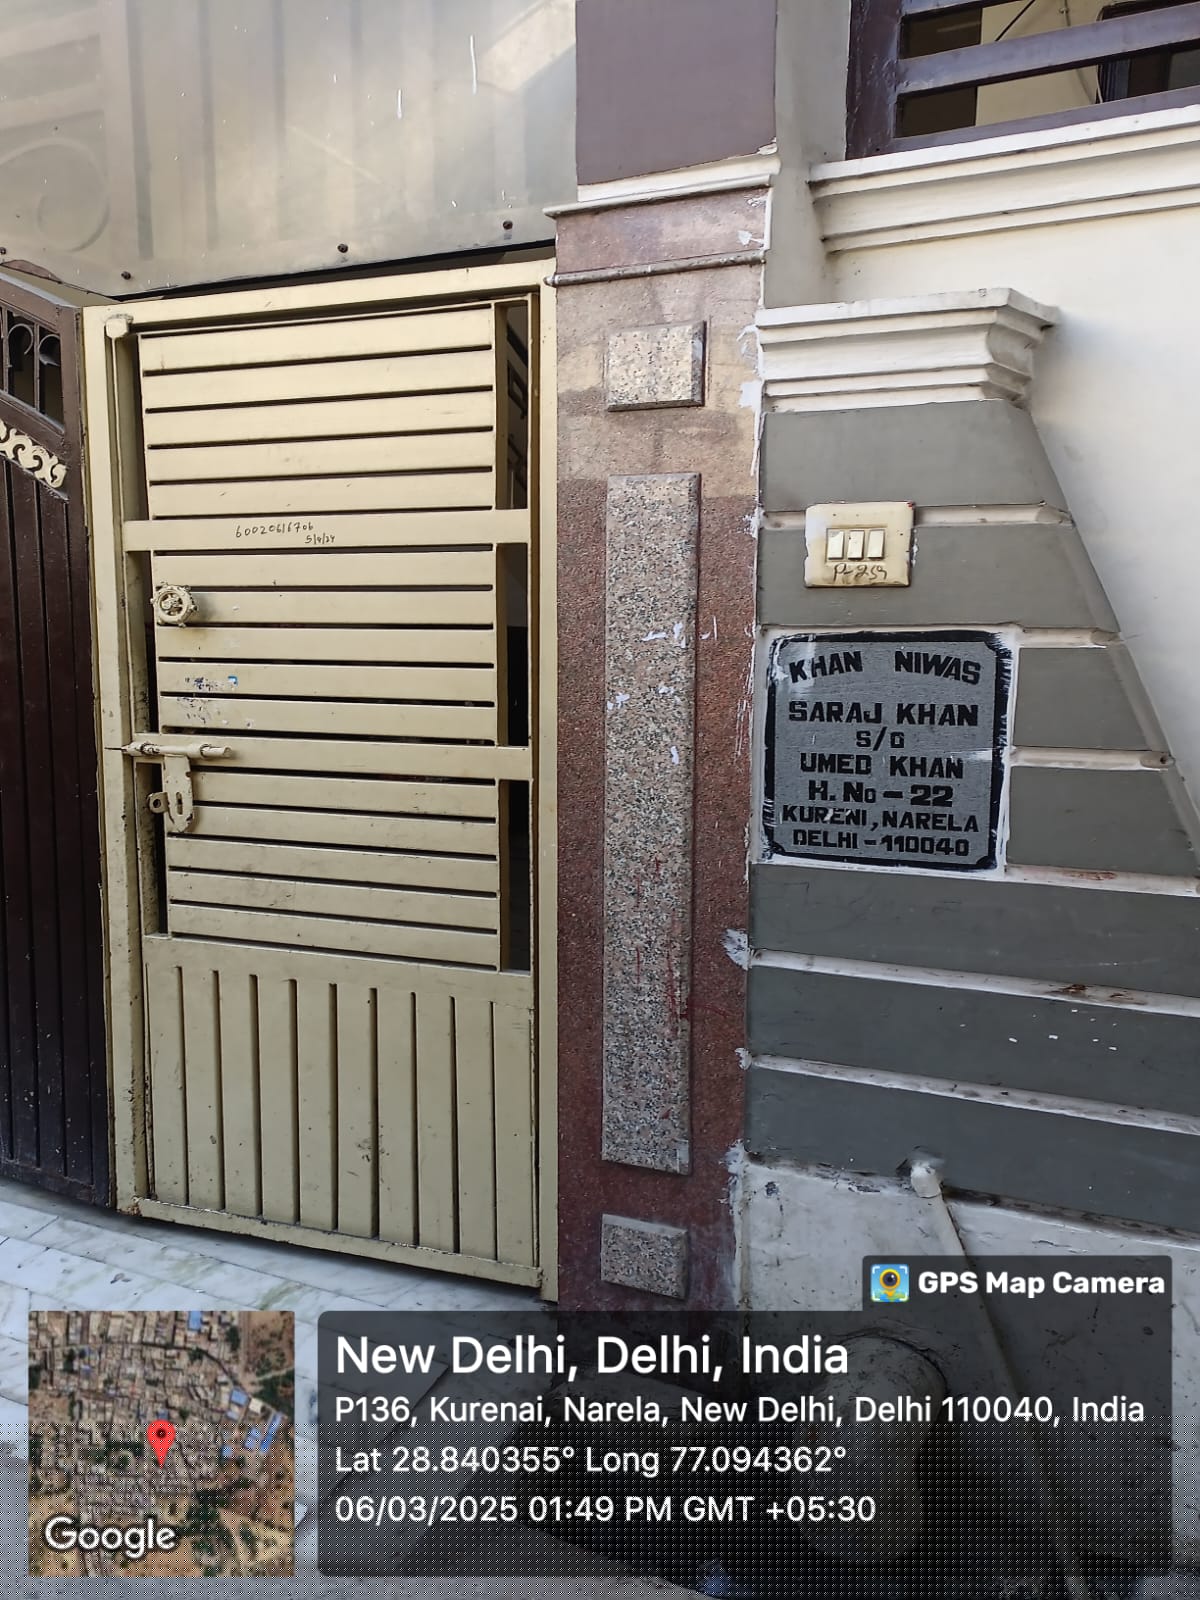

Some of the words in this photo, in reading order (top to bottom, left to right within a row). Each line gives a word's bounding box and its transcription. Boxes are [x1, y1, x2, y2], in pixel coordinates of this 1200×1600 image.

[789, 650, 863, 683] KHAN
[894, 650, 981, 685] NIWAS
[788, 701, 882, 724] SARAJ
[896, 704, 979, 726] KHAN
[800, 753, 872, 775] UMED
[889, 755, 964, 779] KHAN
